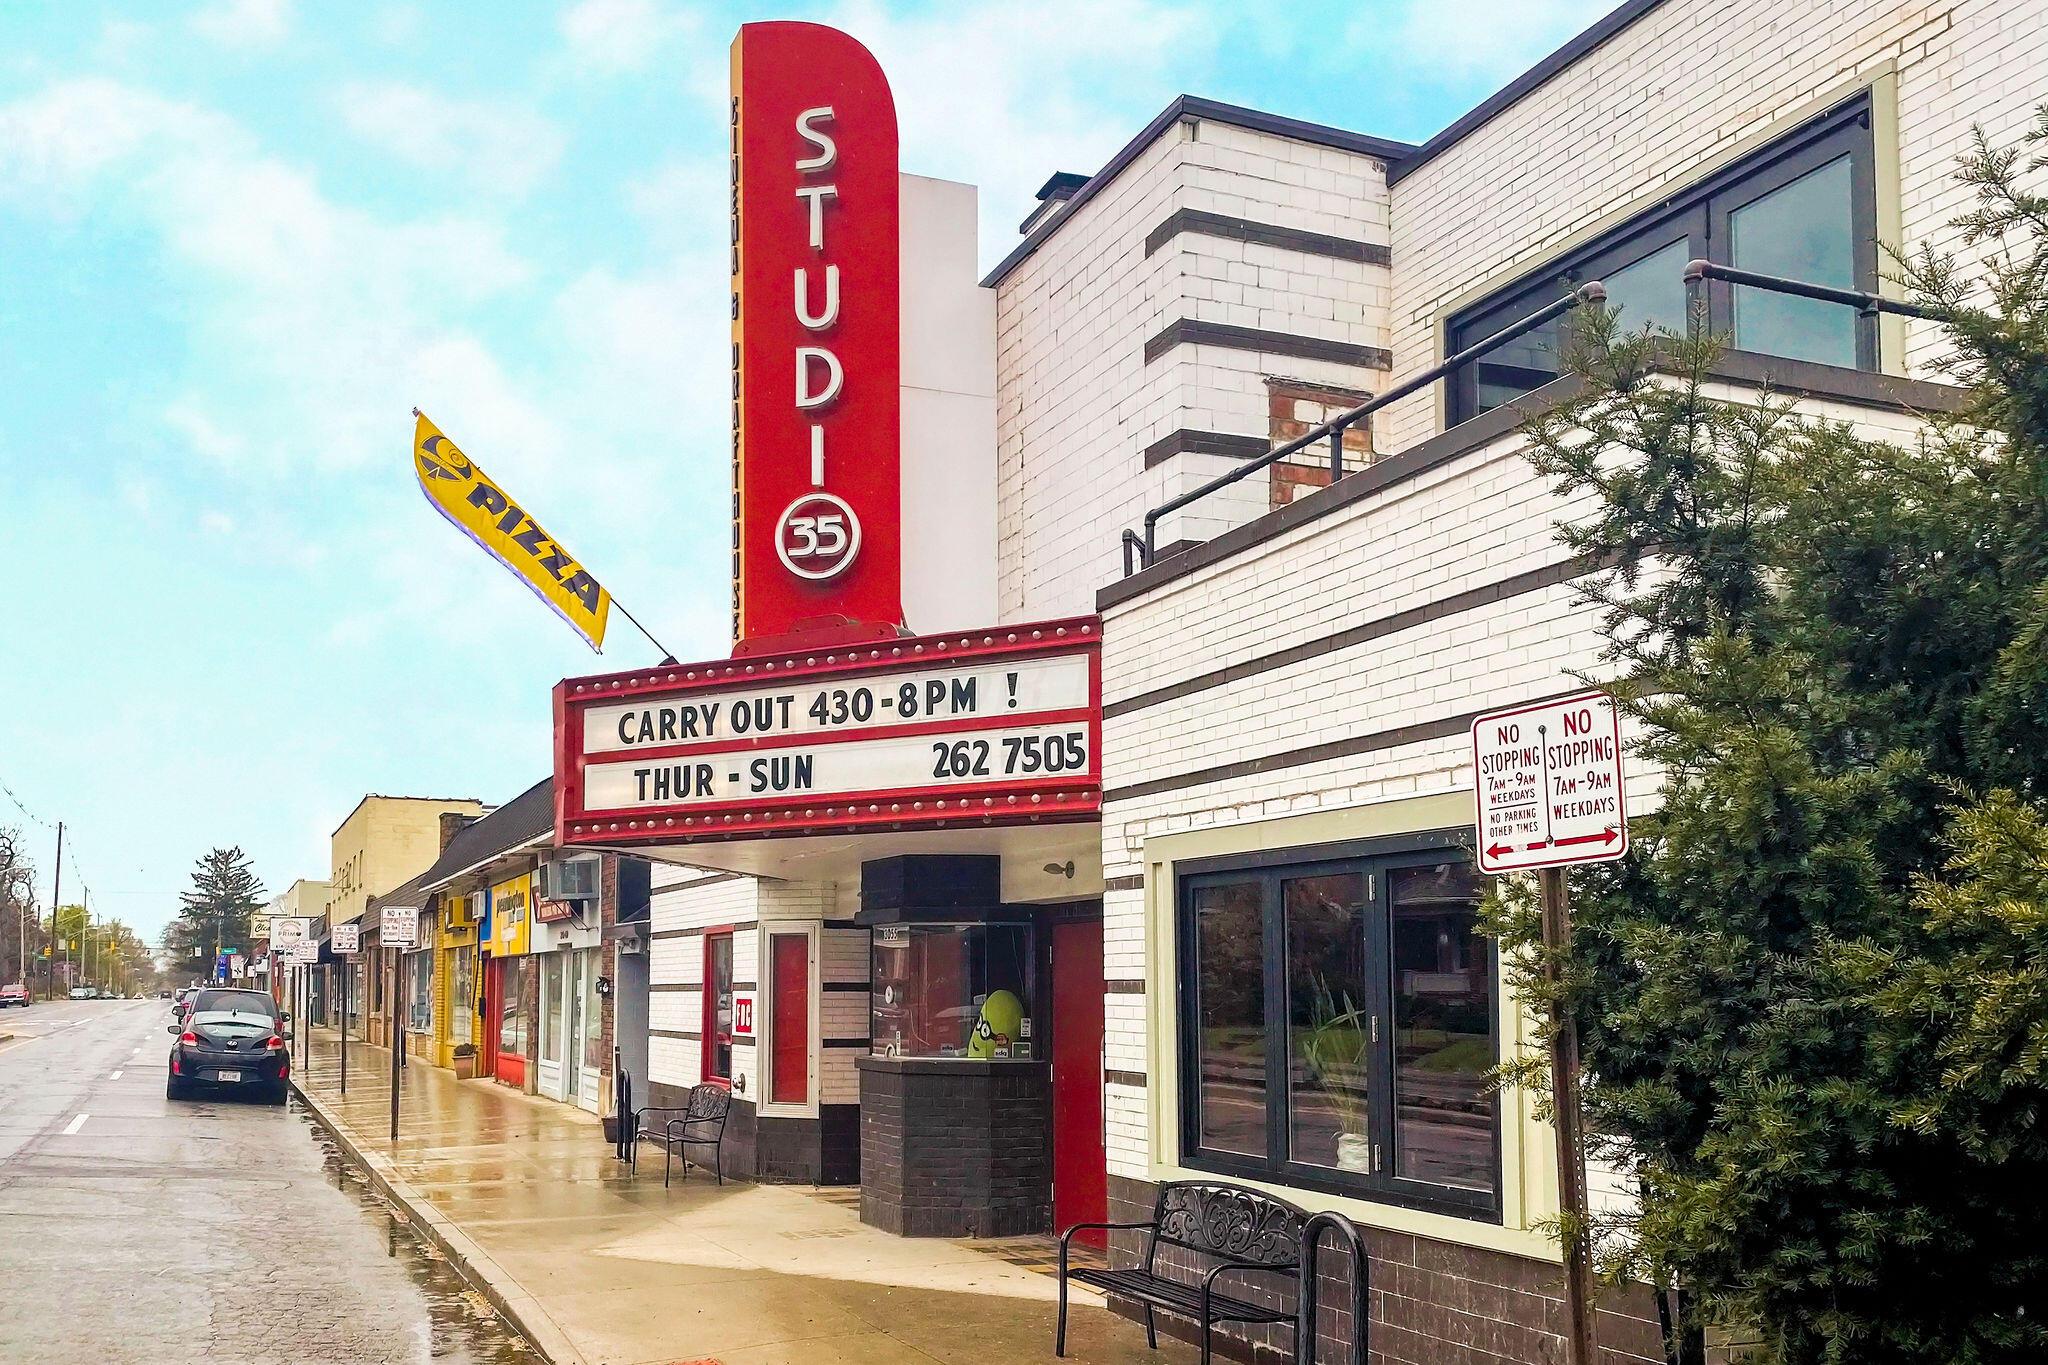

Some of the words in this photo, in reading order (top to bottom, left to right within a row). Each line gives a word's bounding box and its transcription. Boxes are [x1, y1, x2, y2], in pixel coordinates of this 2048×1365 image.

[466, 482, 600, 615] PIZZA
[787, 514, 848, 557] 35
[618, 703, 720, 744] CARRY
[731, 695, 795, 734] OUT
[1006, 673, 1019, 708] !
[1498, 724, 1519, 745] NO
[1563, 709, 1592, 737] NO
[933, 740, 990, 778] 262
[1002, 732, 1086, 774] 7505
[1482, 746, 1540, 775] STOPPING
[1549, 736, 1613, 770] STOPPING
[634, 764, 714, 801] THUR
[750, 755, 813, 792] SUN
[1490, 788, 1536, 804] WEEKDAYS
[1554, 797, 1615, 820] WEEKDAYS
[1489, 824, 1513, 838] OTHER
[1517, 822, 1539, 834] TIMES
[1490, 813, 1501, 824] NO
[1504, 808, 1537, 821] PARKING
[736, 1003, 751, 1027] FDC
